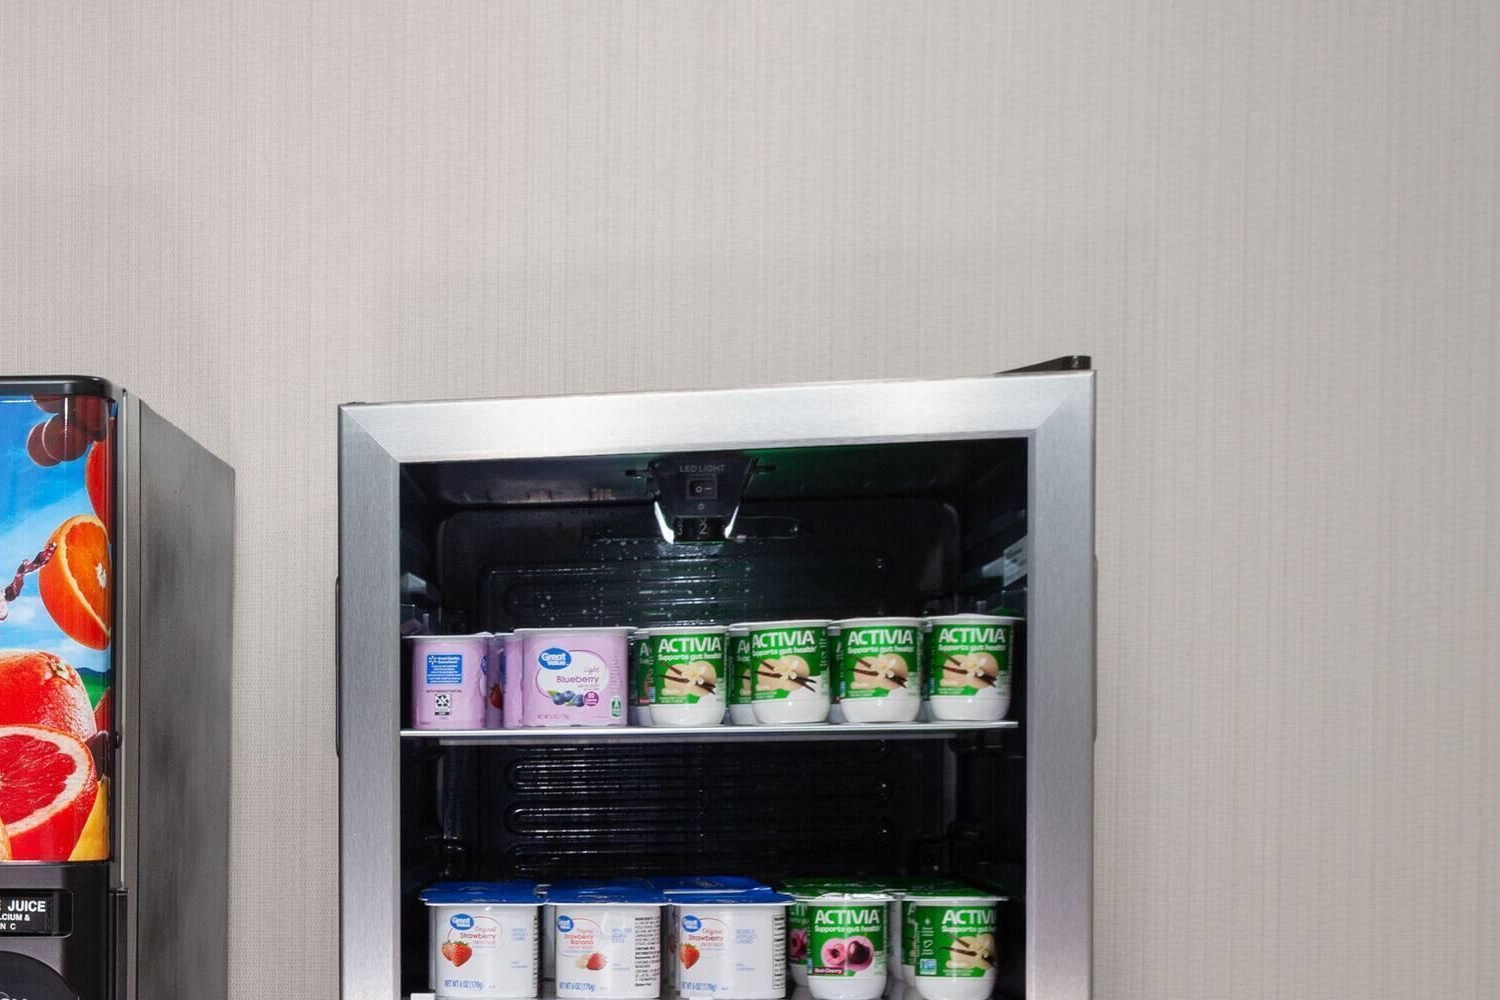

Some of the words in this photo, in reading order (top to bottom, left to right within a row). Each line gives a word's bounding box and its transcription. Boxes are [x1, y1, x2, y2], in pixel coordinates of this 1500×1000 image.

[680, 464, 697, 473] LED
[699, 464, 725, 473] LIGHT
[752, 630, 816, 648] ACTIVIA
[848, 629, 914, 646] ACTIVIA
[938, 627, 1006, 643] ACTIVIA
[658, 636, 722, 653] ACTIVIA
[541, 652, 566, 661] Great
[556, 675, 599, 684] Blueberry
[8, 900, 46, 912] JUICE
[24, 913, 31, 921] &
[814, 909, 880, 925] ACTIVIA
[10, 922, 16, 930] C
